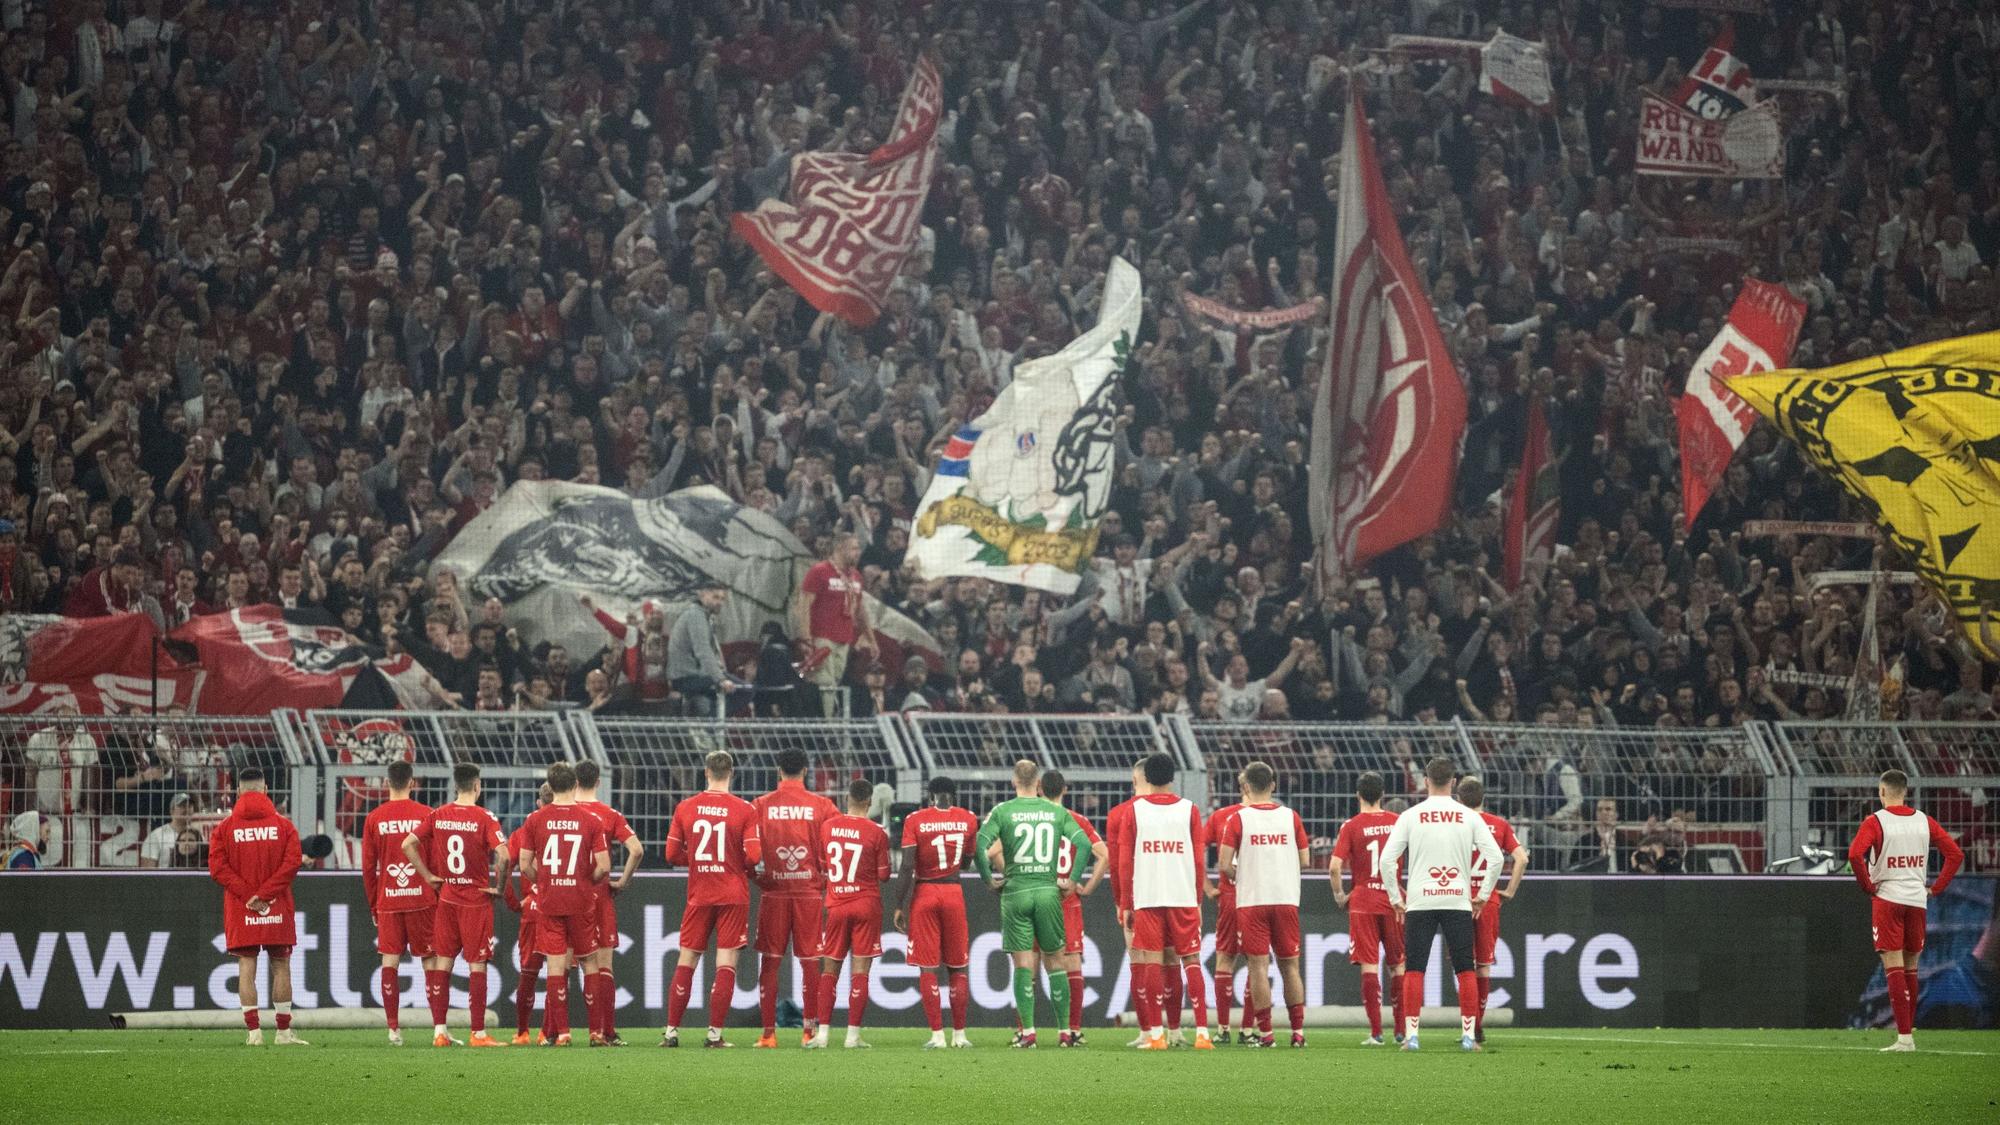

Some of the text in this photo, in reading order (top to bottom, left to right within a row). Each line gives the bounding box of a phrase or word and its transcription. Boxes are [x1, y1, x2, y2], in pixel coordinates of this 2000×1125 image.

[1641, 134, 1724, 163] WAND
[697, 805, 729, 817] TIGGES
[768, 806, 814, 820] REWE
[1011, 810, 1056, 822] SCHWÄBE
[1420, 811, 1464, 824] REWE
[378, 819, 422, 835] REWE
[546, 820, 580, 831] OLESEN
[919, 821, 968, 832] SCHINDLER
[233, 826, 279, 843] REWE
[831, 827, 860, 839] MAINA
[692, 818, 726, 862] 21
[1013, 822, 1055, 864] 20
[1250, 834, 1288, 846] REWE
[931, 833, 965, 870] 17
[1142, 841, 1184, 854] REWE
[447, 834, 466, 875] 8
[542, 834, 583, 875] 47
[826, 841, 863, 883] 37
[1887, 855, 1924, 868] REWE
[773, 869, 813, 880] hummel
[385, 885, 423, 897] hummel
[1423, 887, 1464, 897] hummel
[245, 913, 283, 926] hummel
